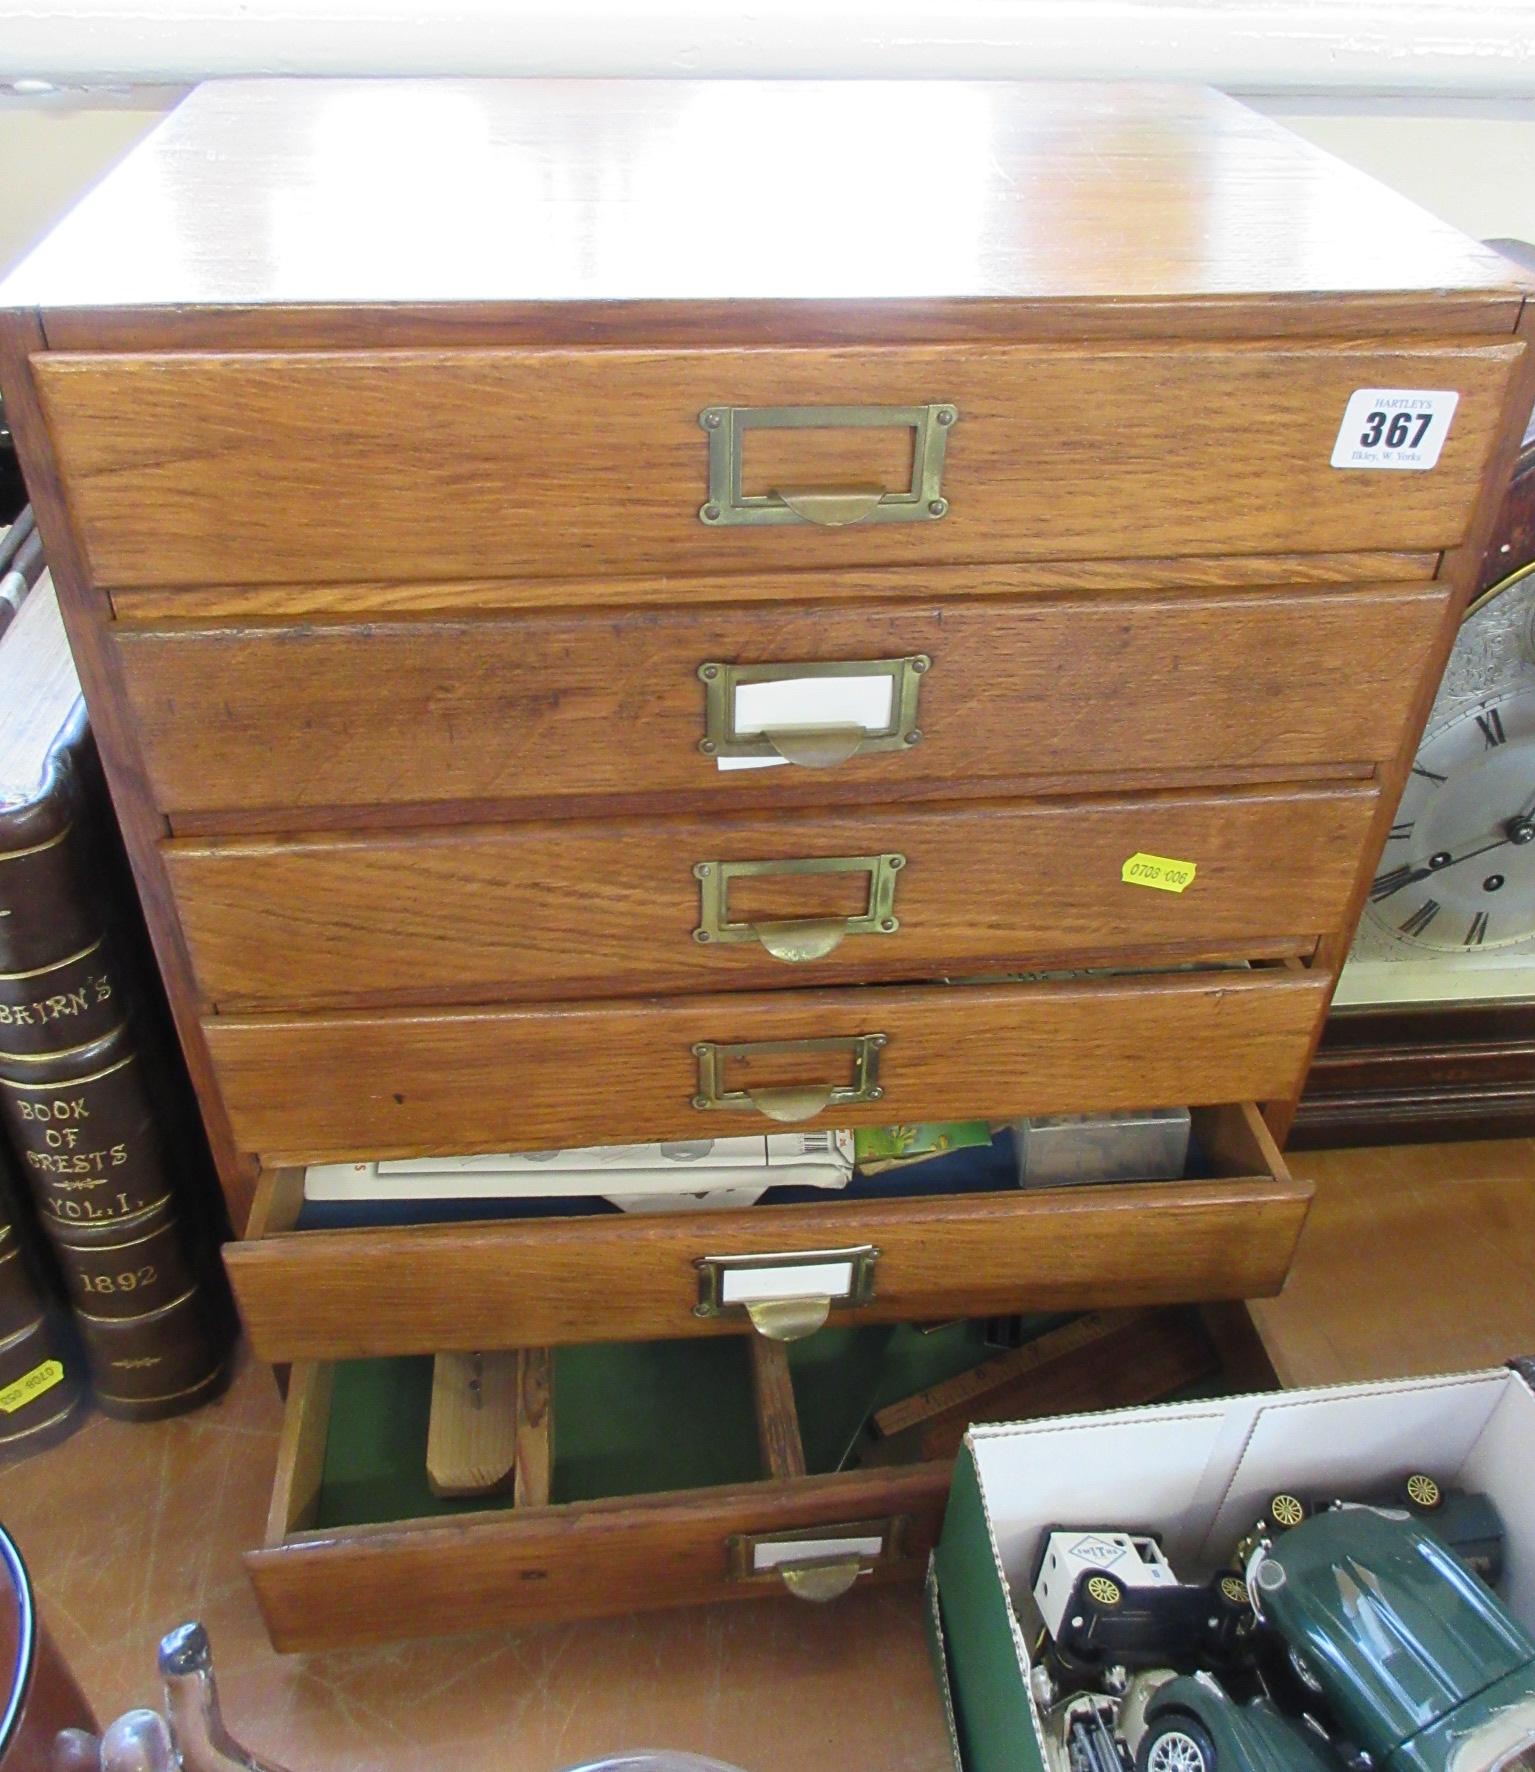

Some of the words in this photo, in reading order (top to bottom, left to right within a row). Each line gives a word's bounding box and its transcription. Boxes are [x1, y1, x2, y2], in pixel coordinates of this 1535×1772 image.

[1374, 398, 1432, 409] HARTLEYS
[1360, 411, 1433, 448] 367
[17, 1097, 89, 1121] BOOK
[46, 1128, 79, 1148] OF
[26, 1144, 127, 1173] CRESTS
[80, 1265, 157, 1293] 1892
